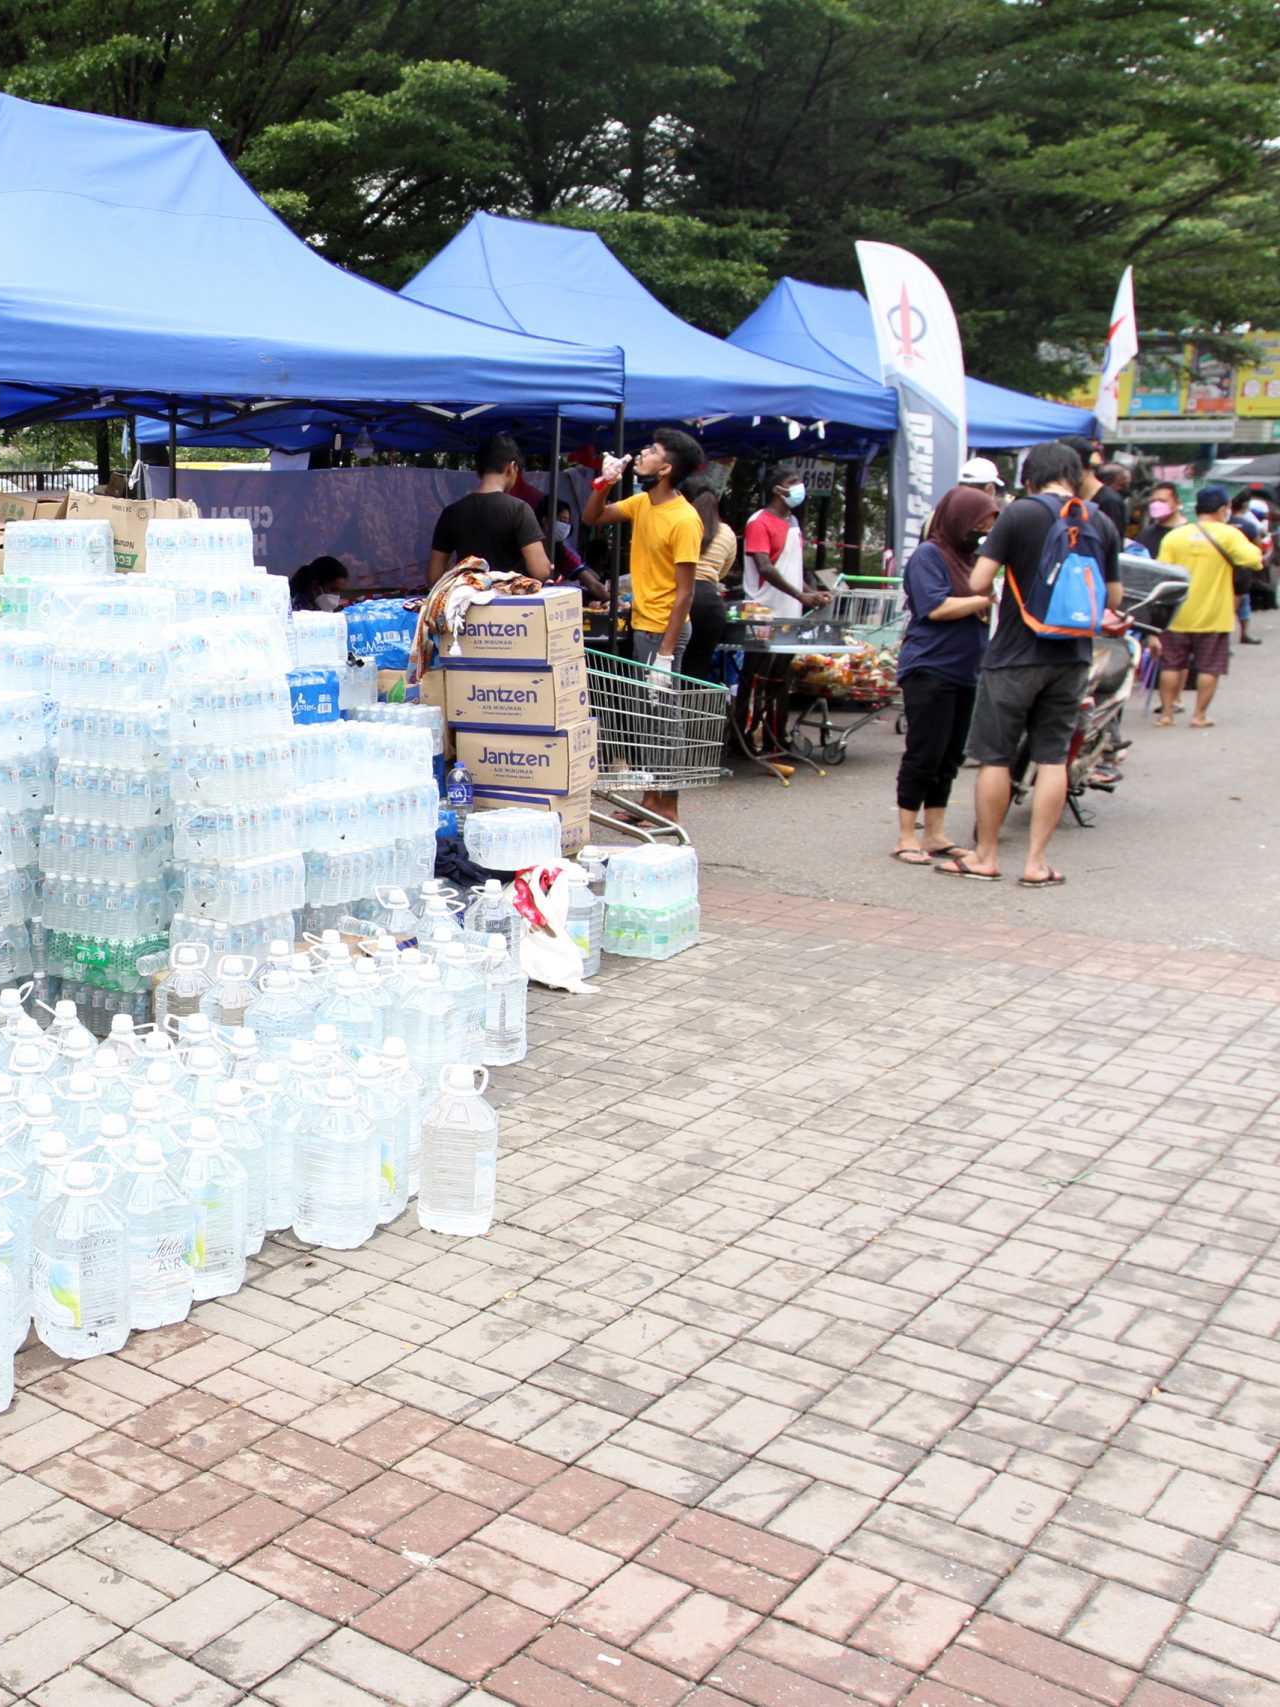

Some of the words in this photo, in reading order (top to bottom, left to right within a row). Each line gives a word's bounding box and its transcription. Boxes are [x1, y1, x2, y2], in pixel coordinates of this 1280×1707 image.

[457, 621, 528, 637] Jantzen
[467, 684, 538, 703] Jantzen
[478, 746, 550, 767] Jantzen
